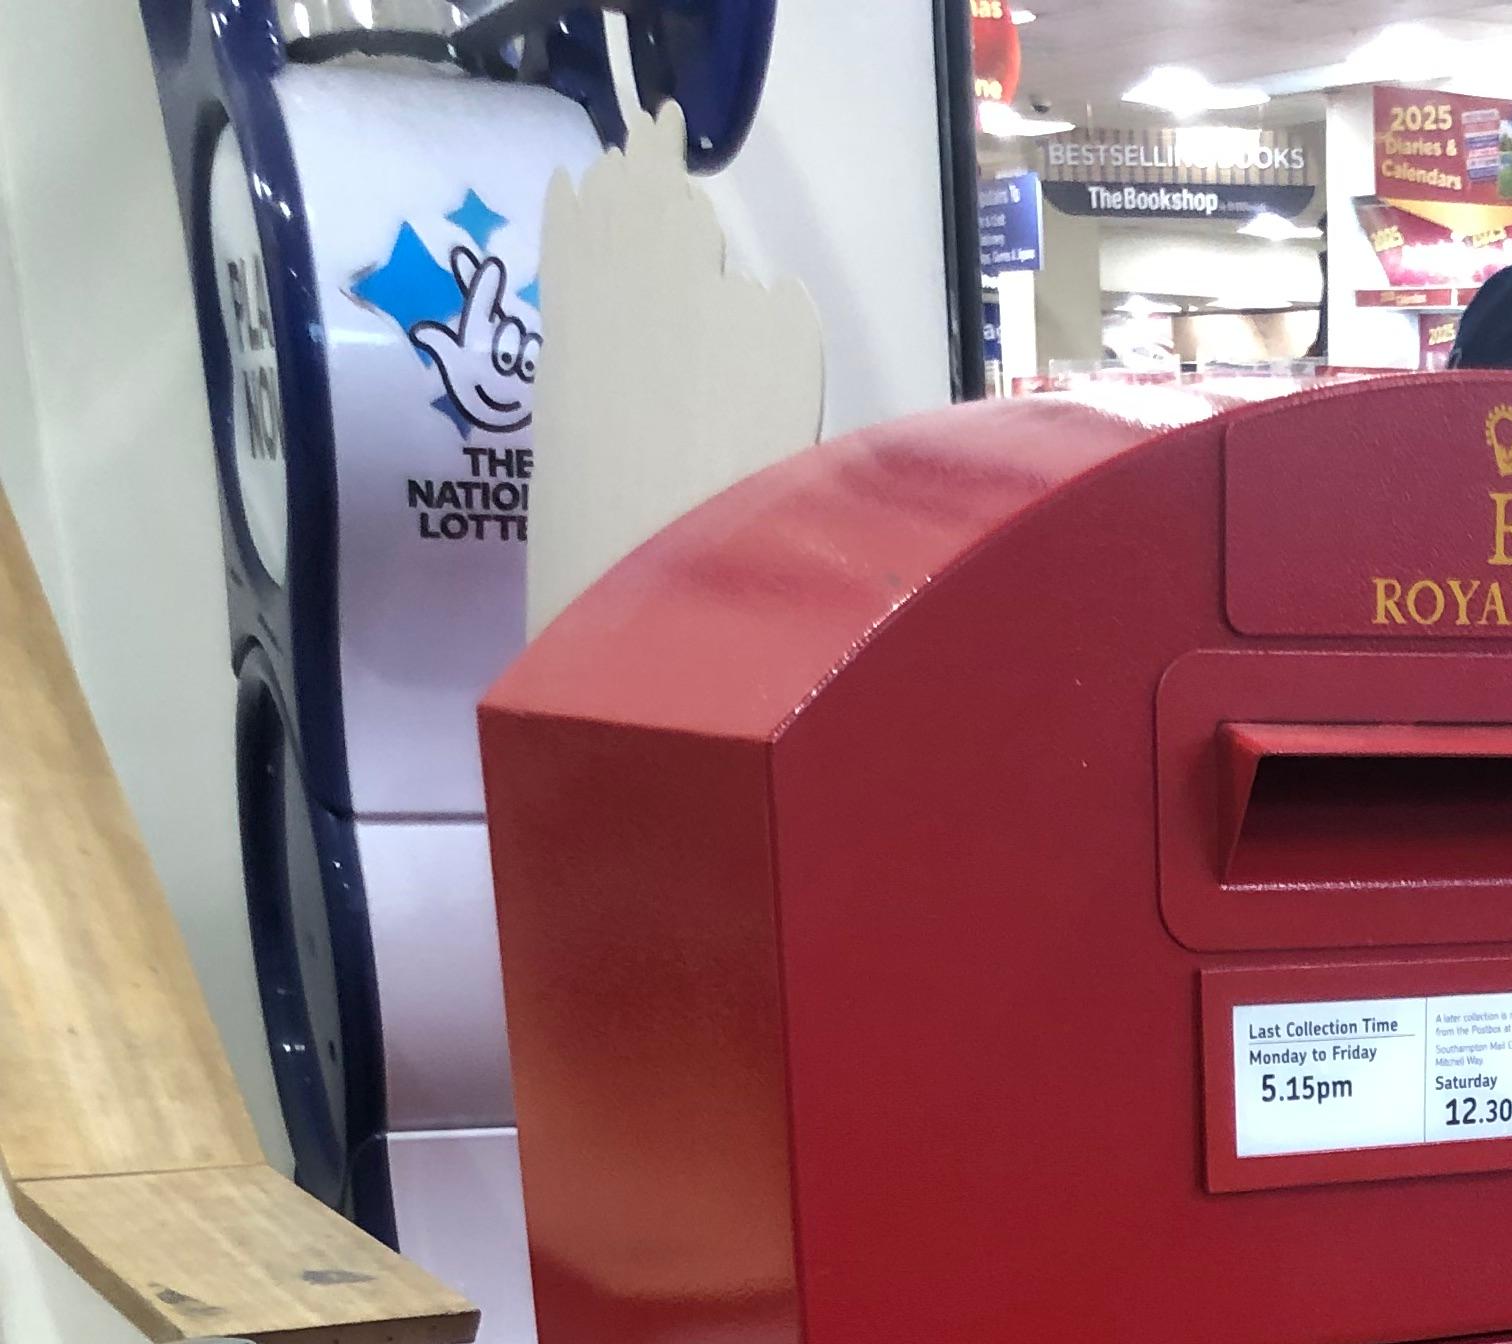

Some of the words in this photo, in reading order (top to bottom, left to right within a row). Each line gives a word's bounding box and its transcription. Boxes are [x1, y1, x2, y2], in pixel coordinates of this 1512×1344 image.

[1390, 105, 1453, 131] 2025
[1382, 159, 1462, 190] Calendars
[462, 446, 534, 478] THE
[1249, 1024, 1282, 1040] Last
[1286, 1019, 1357, 1038] Collection
[1362, 1017, 1398, 1033] Time
[1250, 1049, 1307, 1066] Monday
[1312, 1049, 1327, 1062] to
[1333, 1045, 1377, 1062] Friday
[1262, 1074, 1353, 1104] 5.15pm
[1435, 1074, 1498, 1090] Saturday
